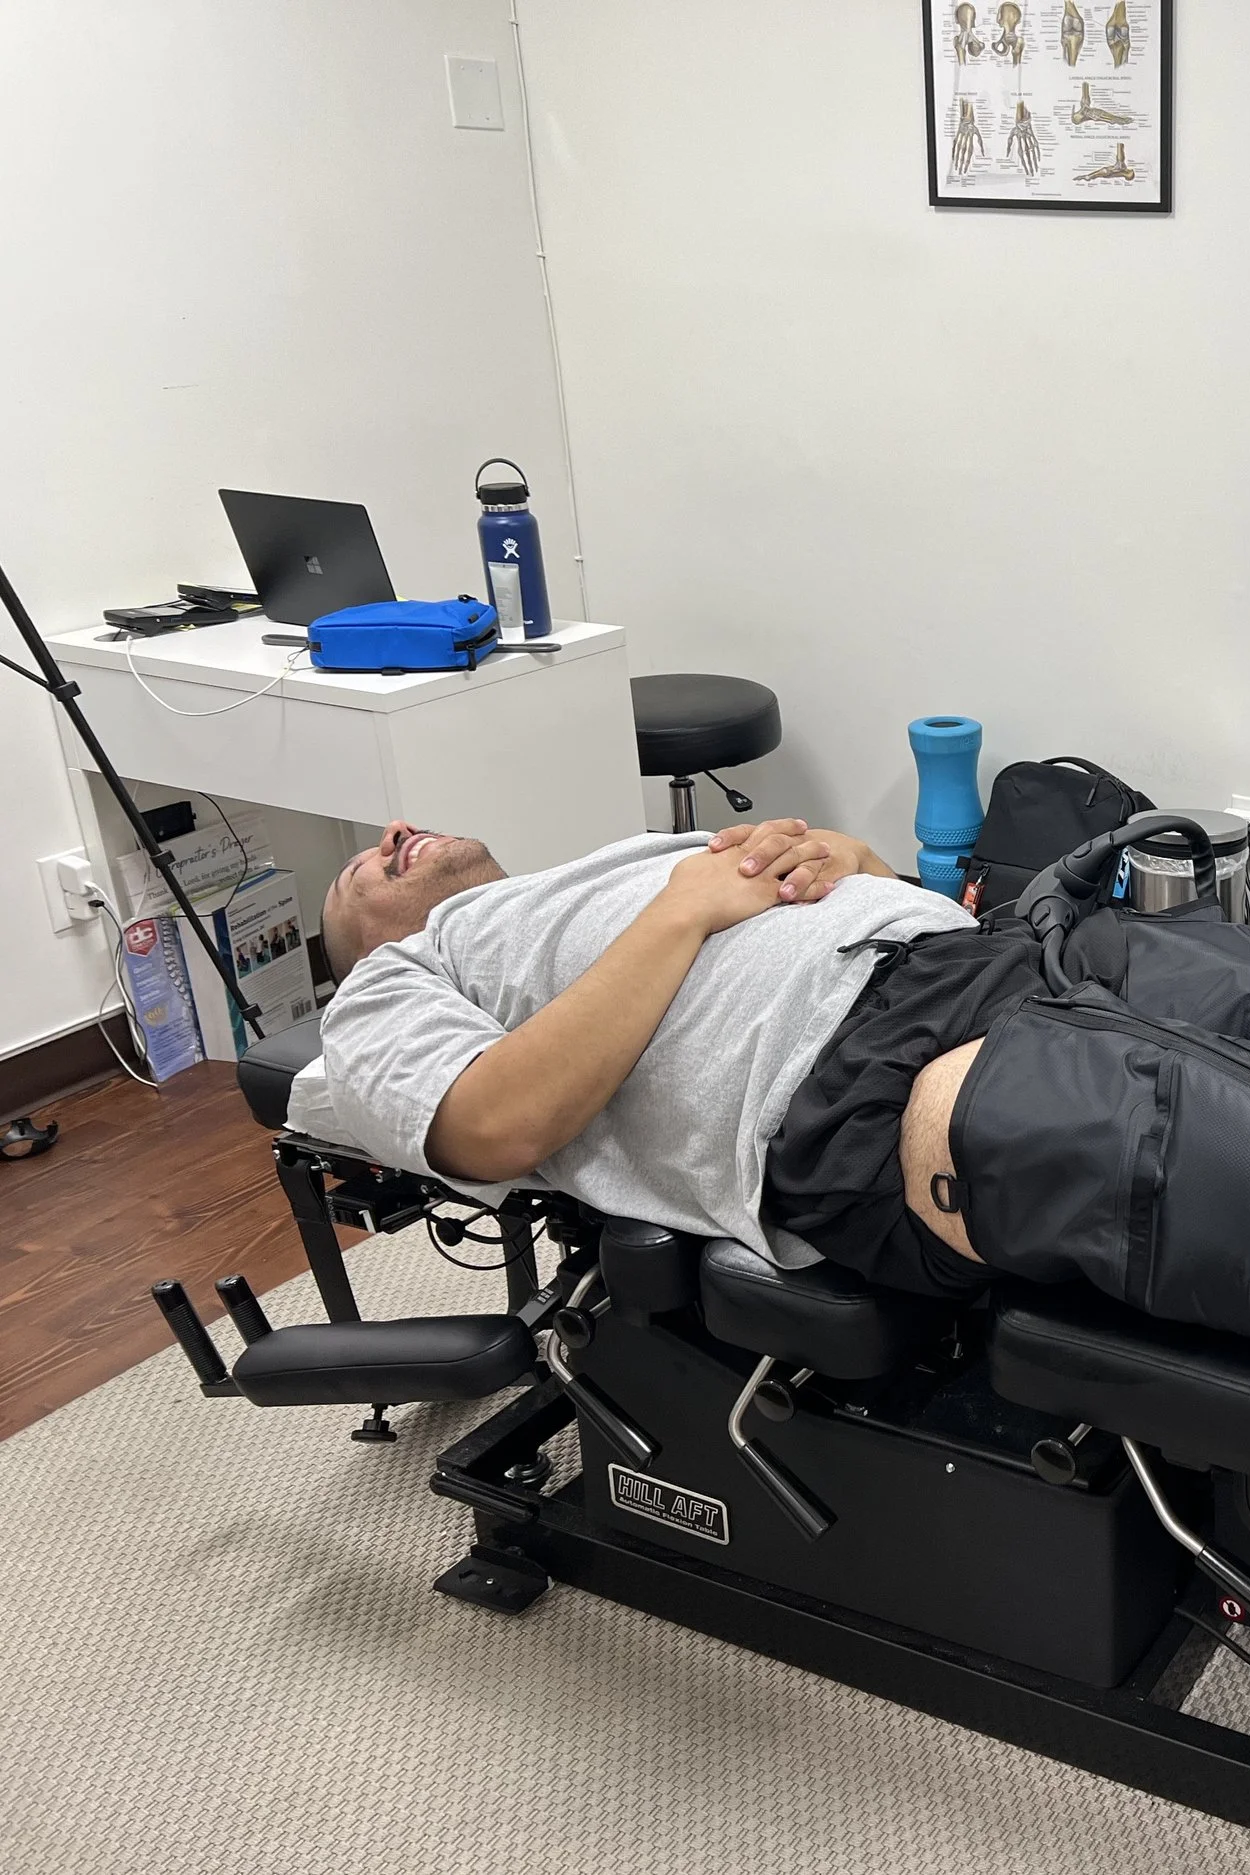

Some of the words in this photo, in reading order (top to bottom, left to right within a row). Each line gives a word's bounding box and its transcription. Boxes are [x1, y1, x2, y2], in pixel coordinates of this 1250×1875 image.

[148, 888, 169, 900] Thank
[230, 910, 267, 932] Rehabilitation
[278, 897, 293, 907] Spine
[618, 1474, 666, 1510] HILL
[671, 1495, 719, 1527] AFT
[619, 1496, 660, 1517] Automatic
[662, 1512, 693, 1528] Flexion
[694, 1524, 718, 1537] Table
